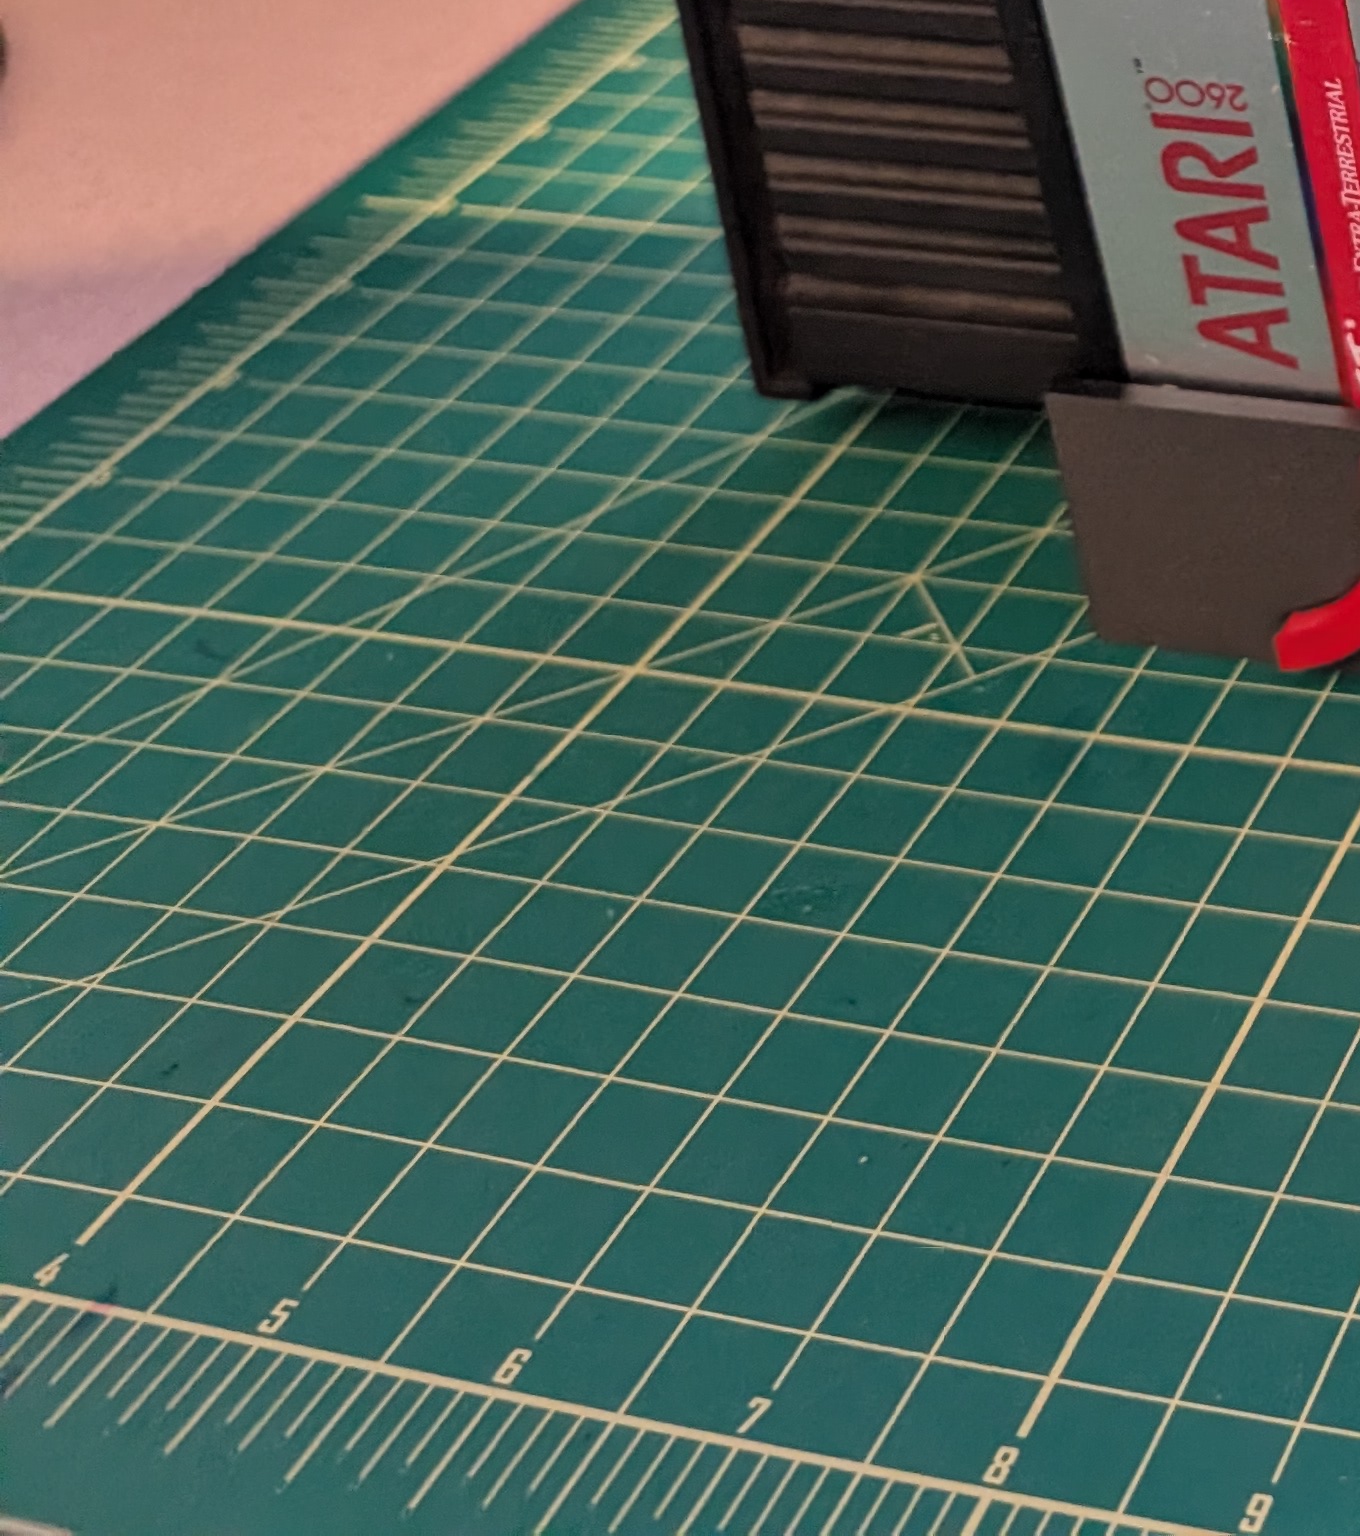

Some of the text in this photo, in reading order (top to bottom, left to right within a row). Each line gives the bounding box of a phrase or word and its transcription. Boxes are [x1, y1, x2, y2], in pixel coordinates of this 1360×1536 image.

[1144, 76, 1249, 112] 2600
[1151, 111, 1300, 370] ATARI
[33, 1252, 1275, 1534] 4 5 6 7 8 9
